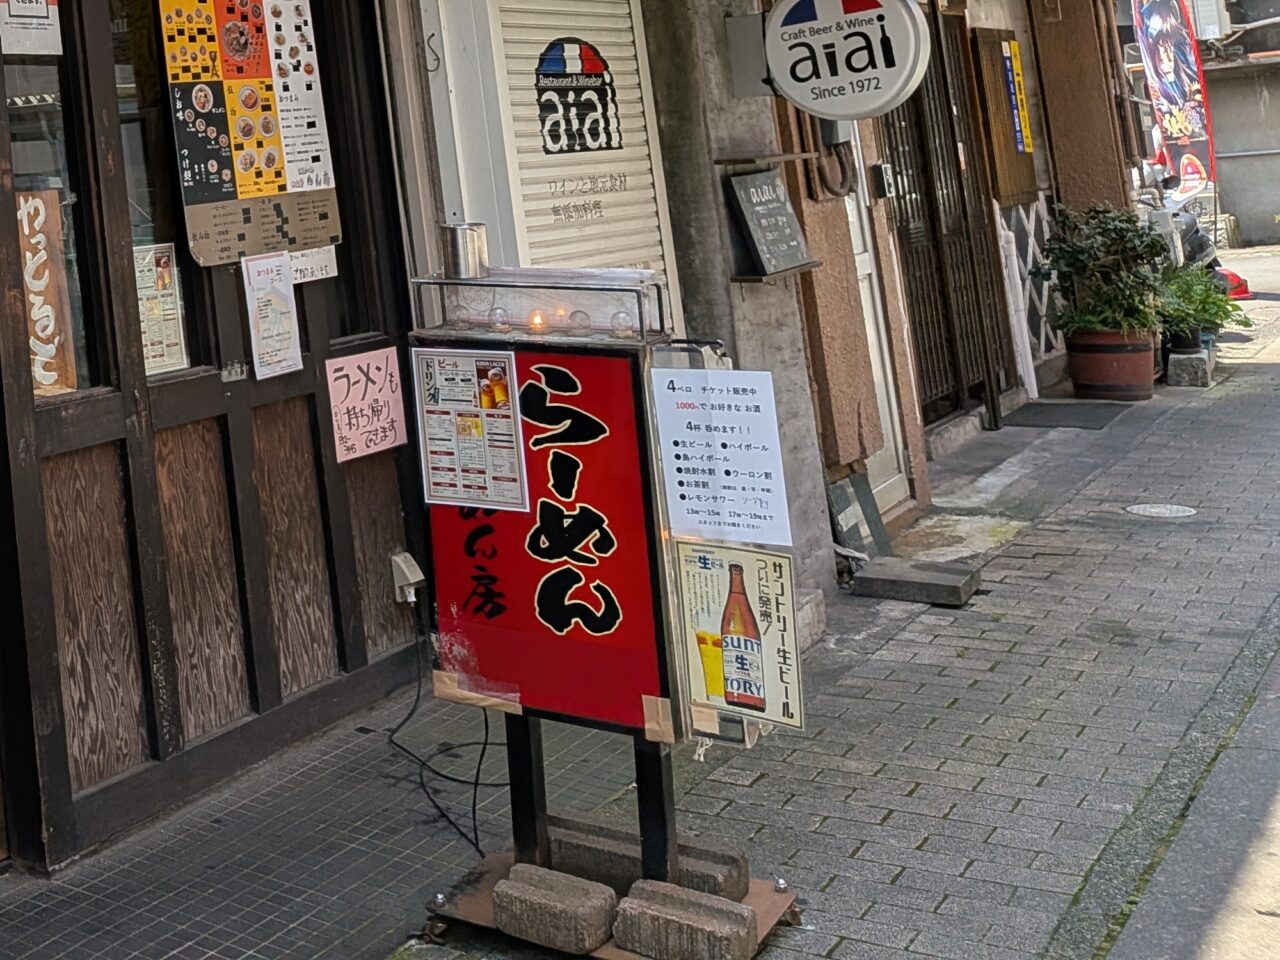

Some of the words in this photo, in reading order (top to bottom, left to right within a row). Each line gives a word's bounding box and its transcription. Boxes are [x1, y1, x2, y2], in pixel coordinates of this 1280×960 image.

[780, 28, 807, 42] Craft
[808, 24, 833, 37] Beer
[835, 21, 845, 32] &
[845, 16, 875, 30] Wine
[787, 14, 896, 83] aiai
[538, 74, 572, 87] Restaurant
[577, 75, 604, 87] Winebar
[810, 86, 846, 100] Since
[848, 77, 882, 94] 1972
[437, 358, 459, 370] ビール
[333, 354, 398, 405] ラーメンも
[424, 360, 438, 403] ドリンク
[700, 386, 757, 396] チケット販売中
[343, 398, 390, 431] 持ち帰り
[709, 404, 742, 413] お好きな
[745, 405, 761, 413] お酒
[360, 417, 397, 448] できます
[685, 421, 701, 432] 4杯
[520, 364, 622, 635] らーめん
[772, 561, 794, 720] サントリー生ビール
